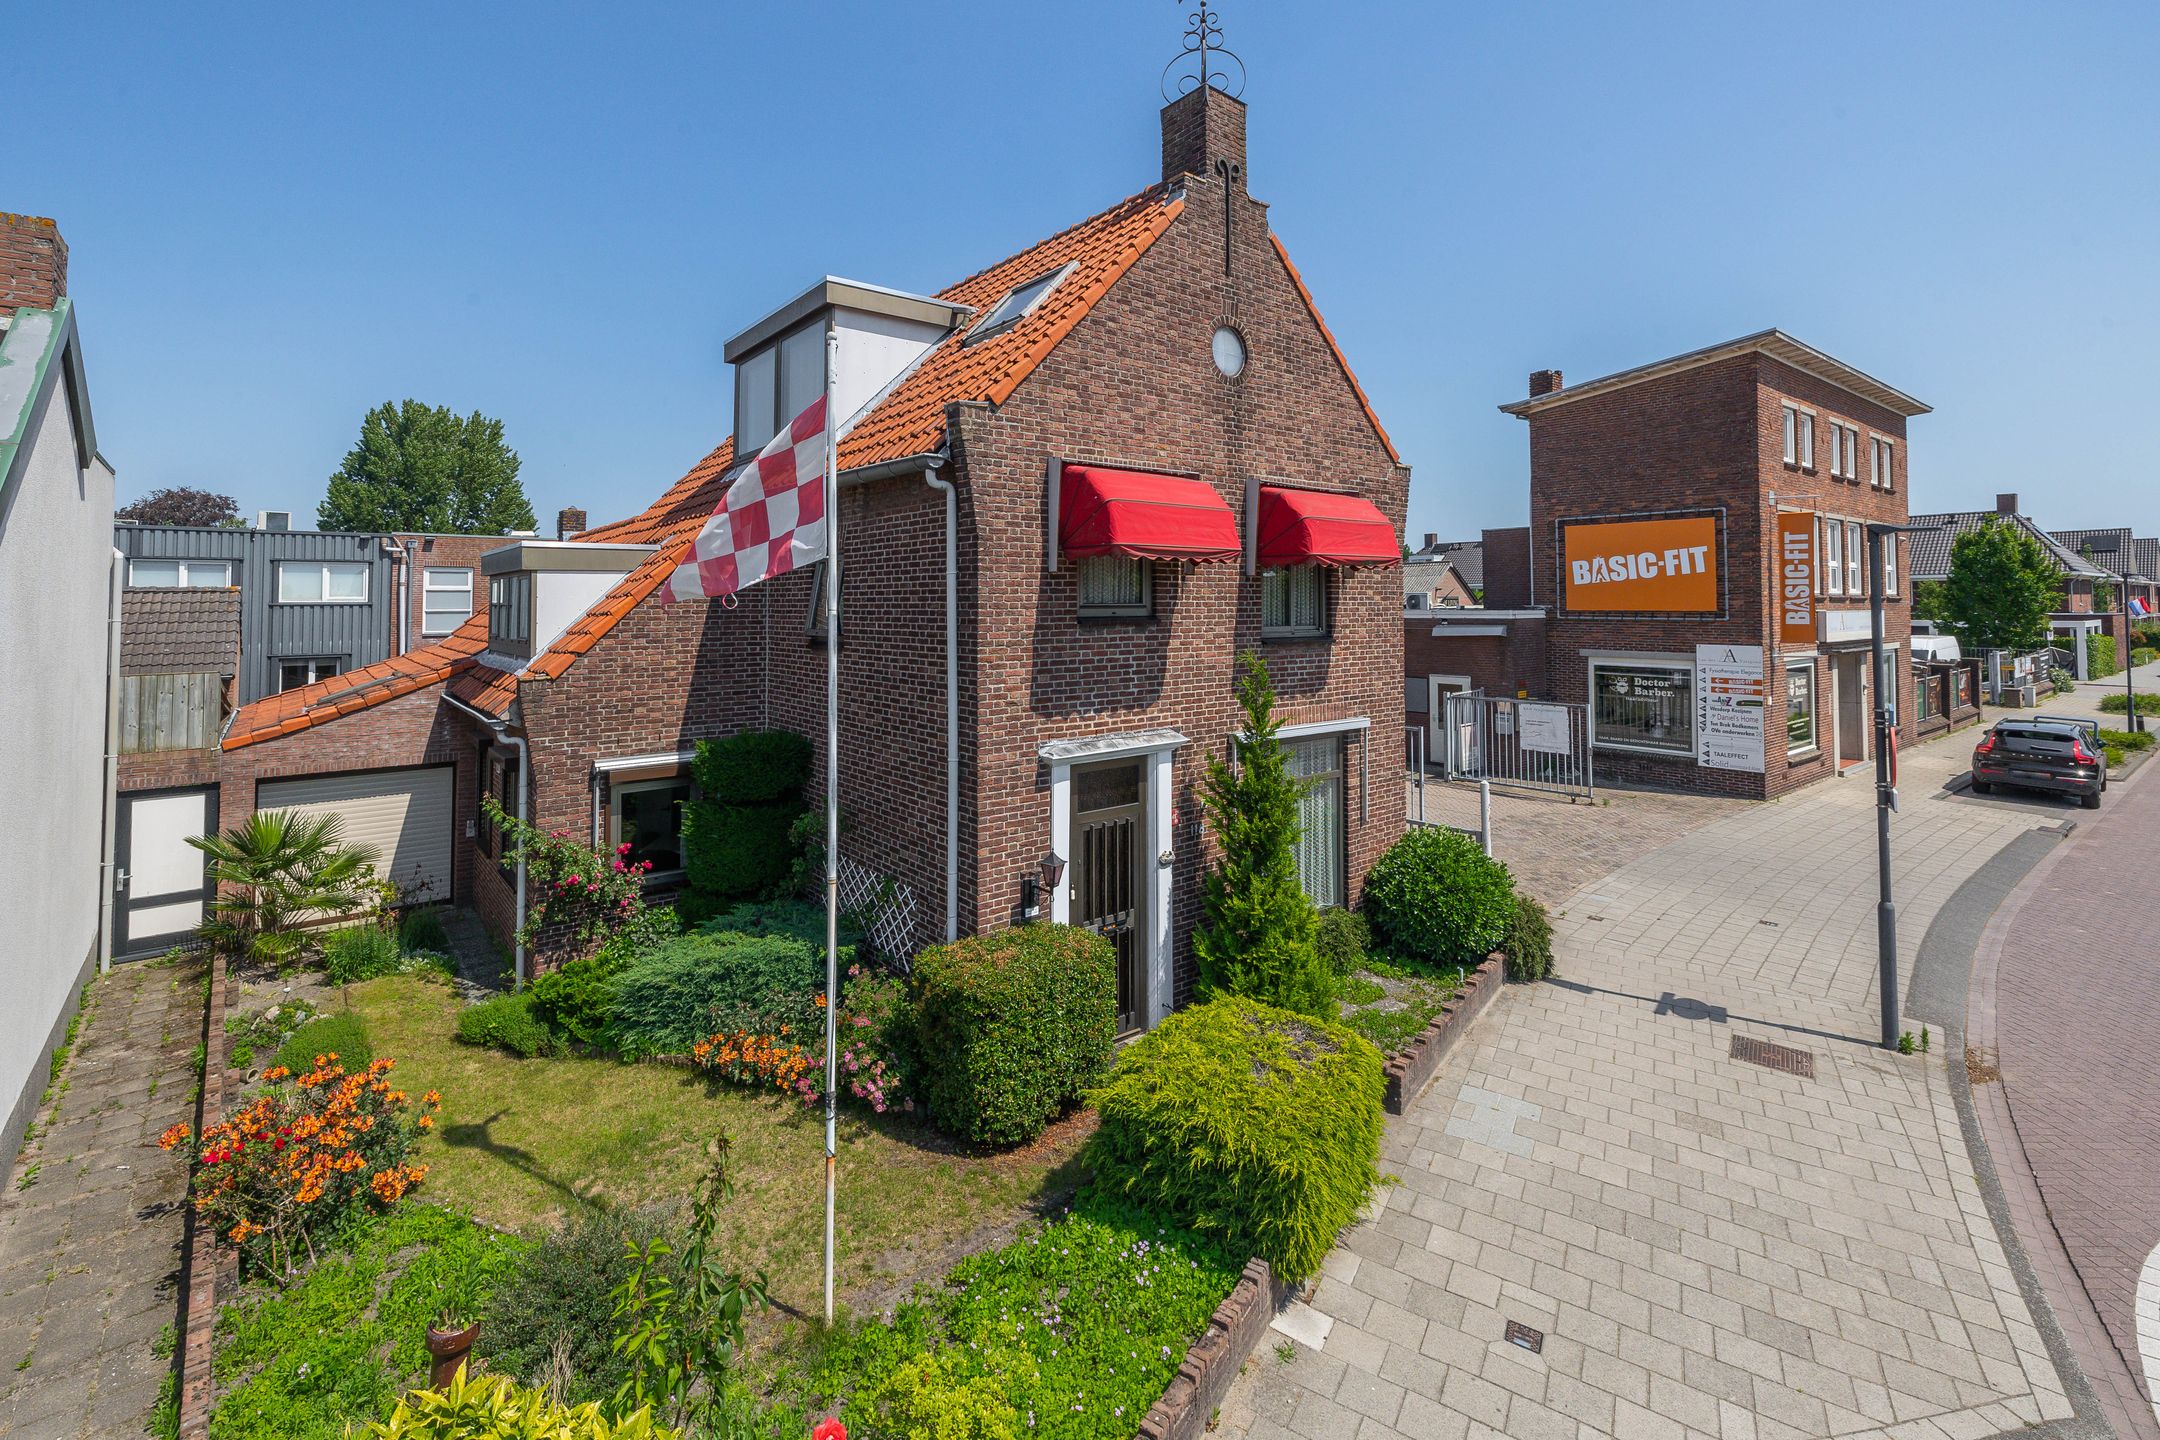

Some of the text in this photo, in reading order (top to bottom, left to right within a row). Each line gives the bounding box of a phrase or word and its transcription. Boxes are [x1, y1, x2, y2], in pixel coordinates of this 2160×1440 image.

[1571, 545, 1708, 586] BASIC-FIT
[1784, 531, 1810, 625] BASIC-FIT
[1634, 677, 1671, 688] Doctor
[1634, 686, 1675, 697] Barber.
[1740, 715, 1760, 724] Home
[1713, 751, 1749, 760] TAALEFFECT
[1710, 760, 1729, 768] Solid
